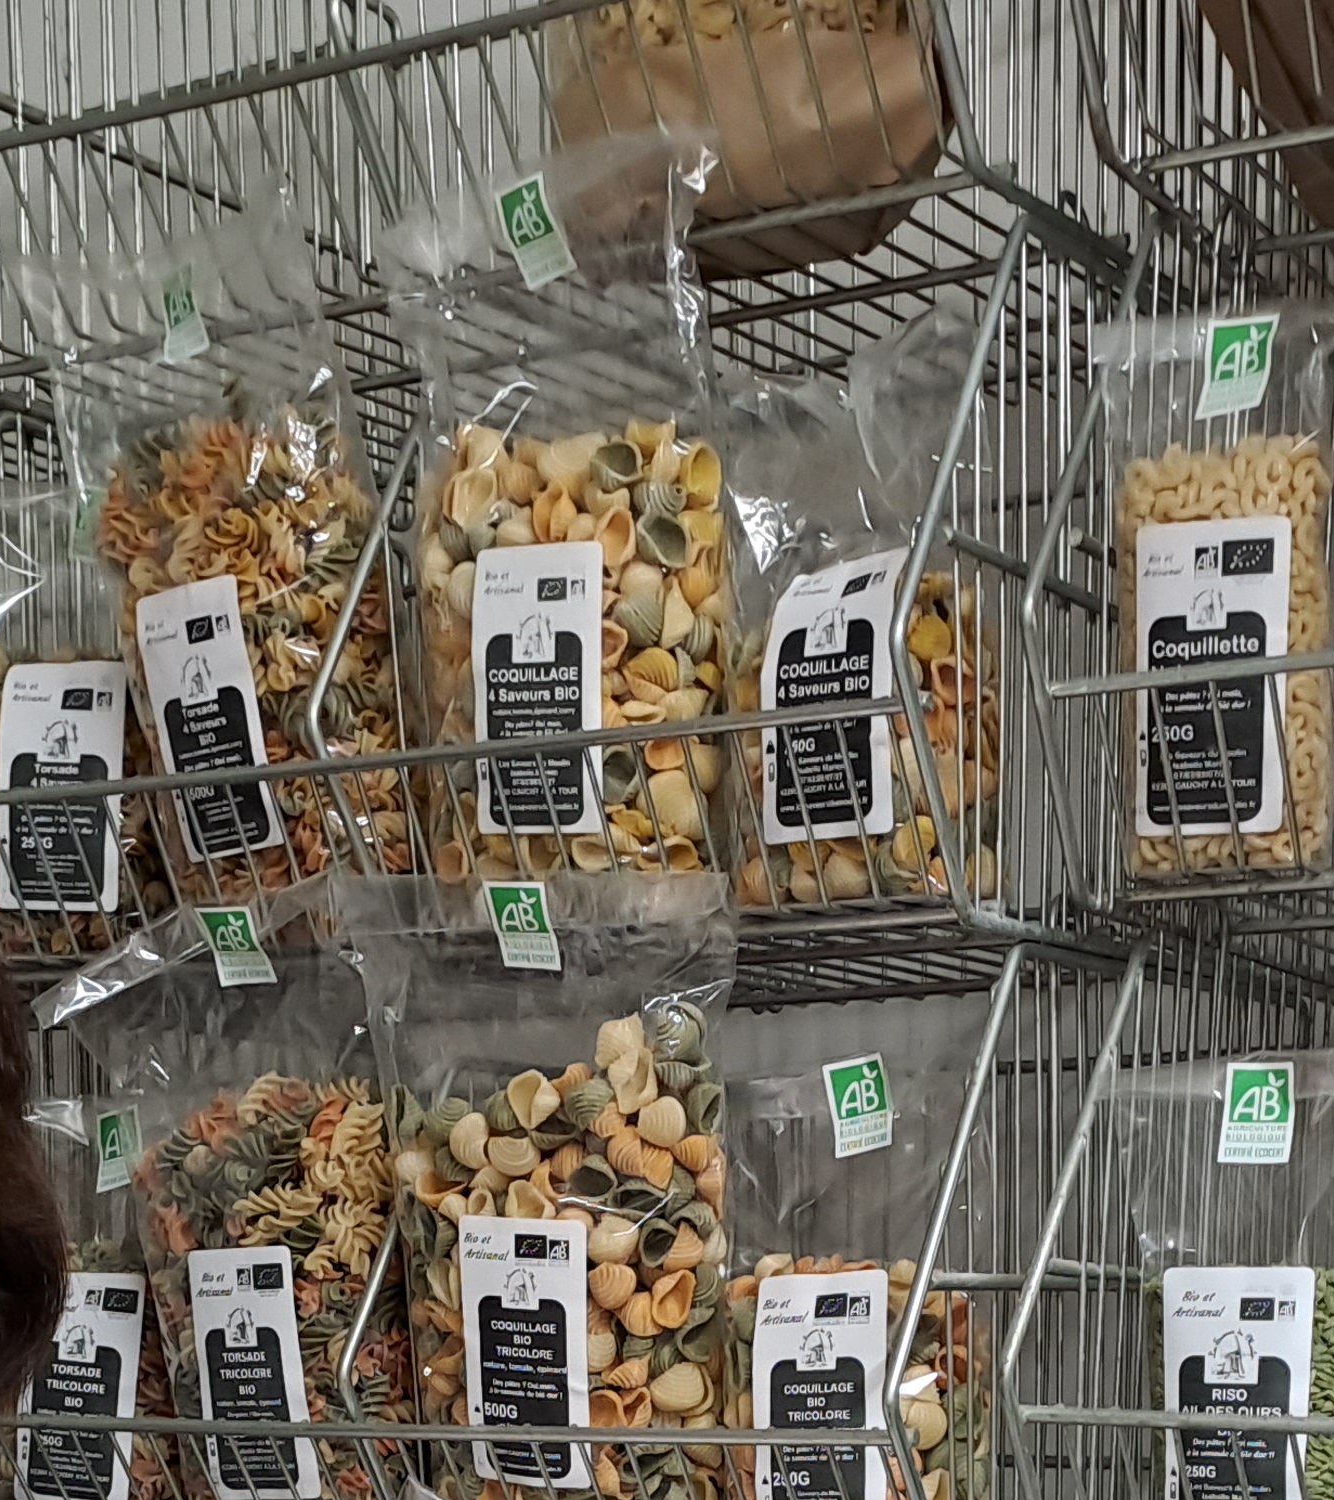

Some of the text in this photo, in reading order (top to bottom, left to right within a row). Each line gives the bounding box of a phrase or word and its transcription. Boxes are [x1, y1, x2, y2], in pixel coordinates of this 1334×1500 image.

[1152, 635, 1259, 662] Coquillette
[489, 667, 578, 682] COQUILLAGE
[780, 655, 870, 680] COQUILLAGE
[845, 676, 870, 693] BIO
[555, 686, 579, 700] BIO
[21, 836, 52, 849] 25G
[501, 902, 539, 932] AB
[841, 1079, 879, 1117] AB
[1233, 1086, 1280, 1120] AB
[464, 1233, 478, 1245] Bio
[491, 1320, 557, 1334] COQUILLAGE
[514, 1334, 531, 1345] BIO
[222, 1351, 266, 1363] TORSADE
[496, 1346, 555, 1361] TRICOLORE
[52, 1364, 101, 1379] TORSADE
[220, 1368, 272, 1380] TRICOLORE
[46, 1378, 105, 1395] TRICOLORE
[239, 1385, 256, 1396] BIO
[784, 1383, 855, 1395] COQUILLAGE
[1212, 1389, 1247, 1401] RISO
[807, 1397, 826, 1408] BIO
[787, 1410, 851, 1422] TRICOLORE
